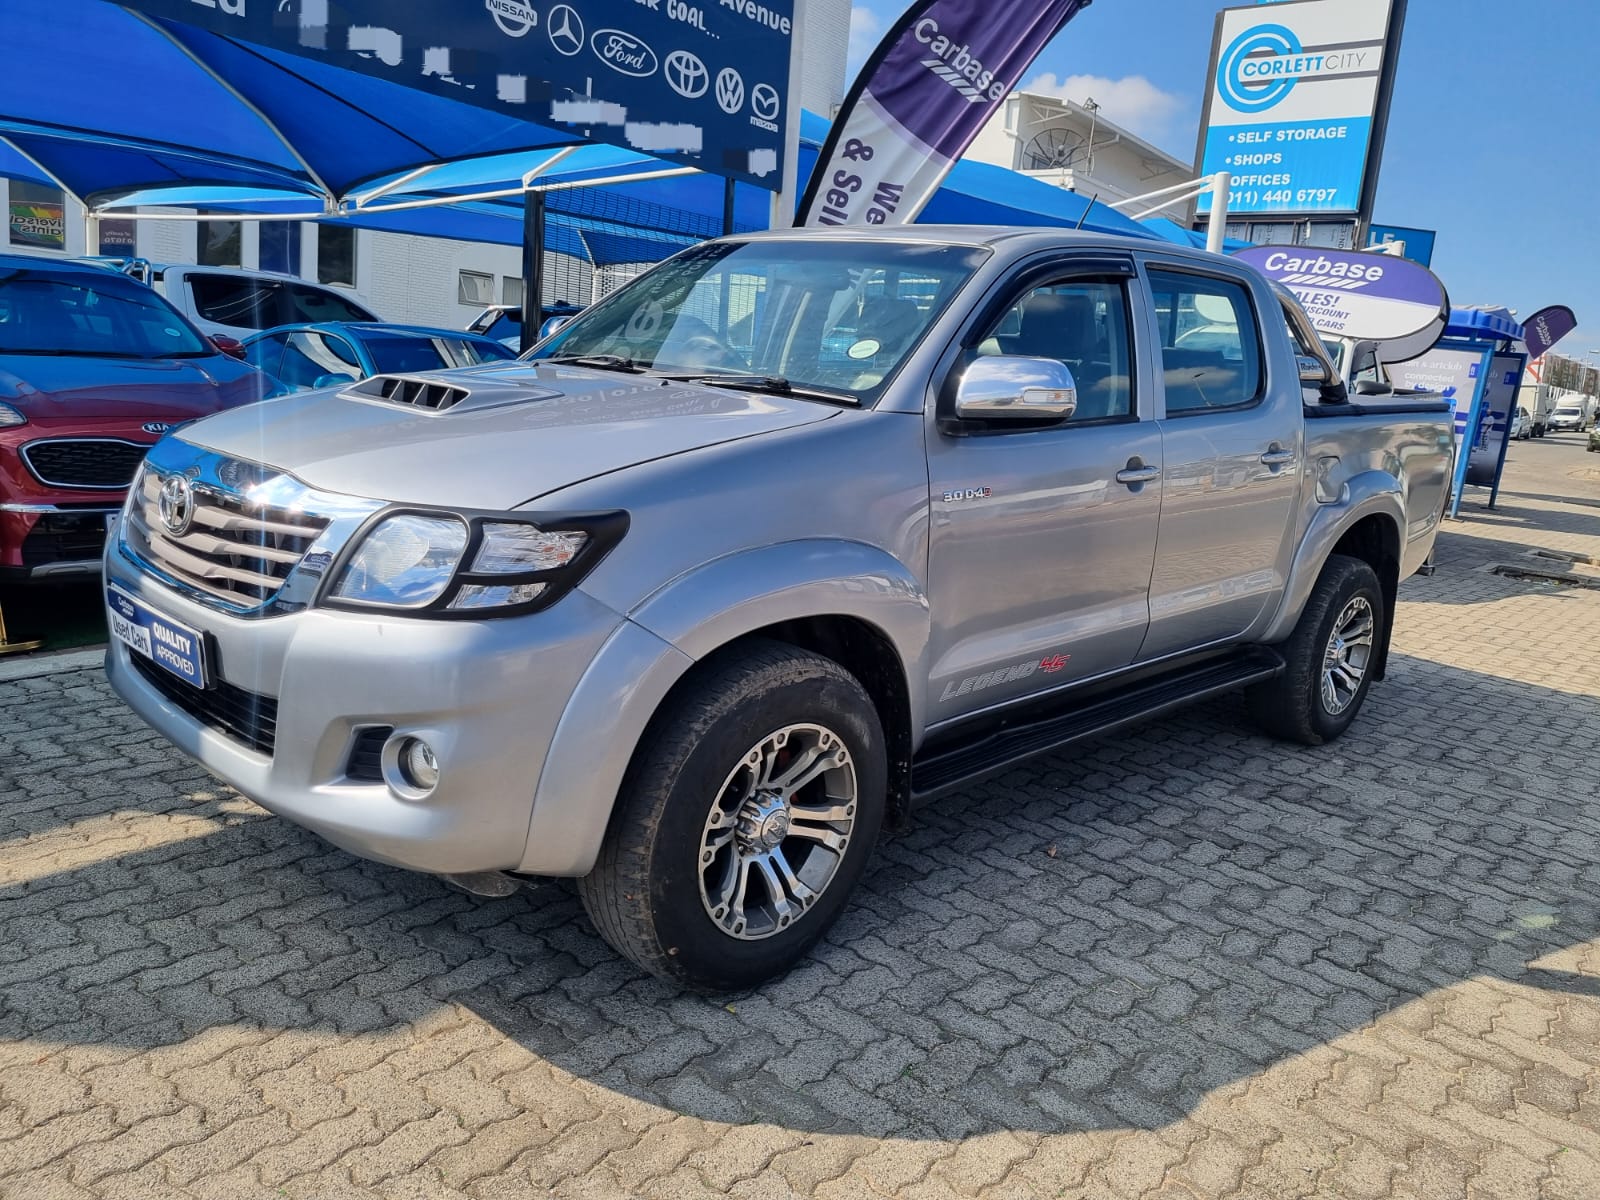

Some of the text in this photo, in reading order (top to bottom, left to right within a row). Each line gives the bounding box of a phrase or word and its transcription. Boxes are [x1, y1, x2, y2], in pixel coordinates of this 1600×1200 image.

[489, 0, 535, 22] NISSAN
[603, 35, 647, 70] Ford
[914, 18, 1005, 100] Carbase
[750, 116, 779, 133] mazda
[1236, 126, 1348, 144] SELF STORAGE
[845, 138, 874, 162] &
[1233, 153, 1282, 166] SHOPS
[1230, 173, 1291, 187] OFFICES
[866, 181, 904, 225] We
[1262, 190, 1292, 204] 440
[1296, 188, 1338, 202] 6797
[1265, 252, 1384, 281] Carbase
[1295, 291, 1340, 308] ALES!
[1304, 305, 1351, 320] ISCOUNT
[1316, 318, 1345, 331] CARS
[1404, 372, 1455, 383] connected
[147, 423, 169, 431] KIA
[112, 615, 150, 653] Used Cars
[152, 621, 192, 656] QUALITY
[156, 644, 195, 676] APPROVED
[939, 660, 1040, 703] LEGEND
